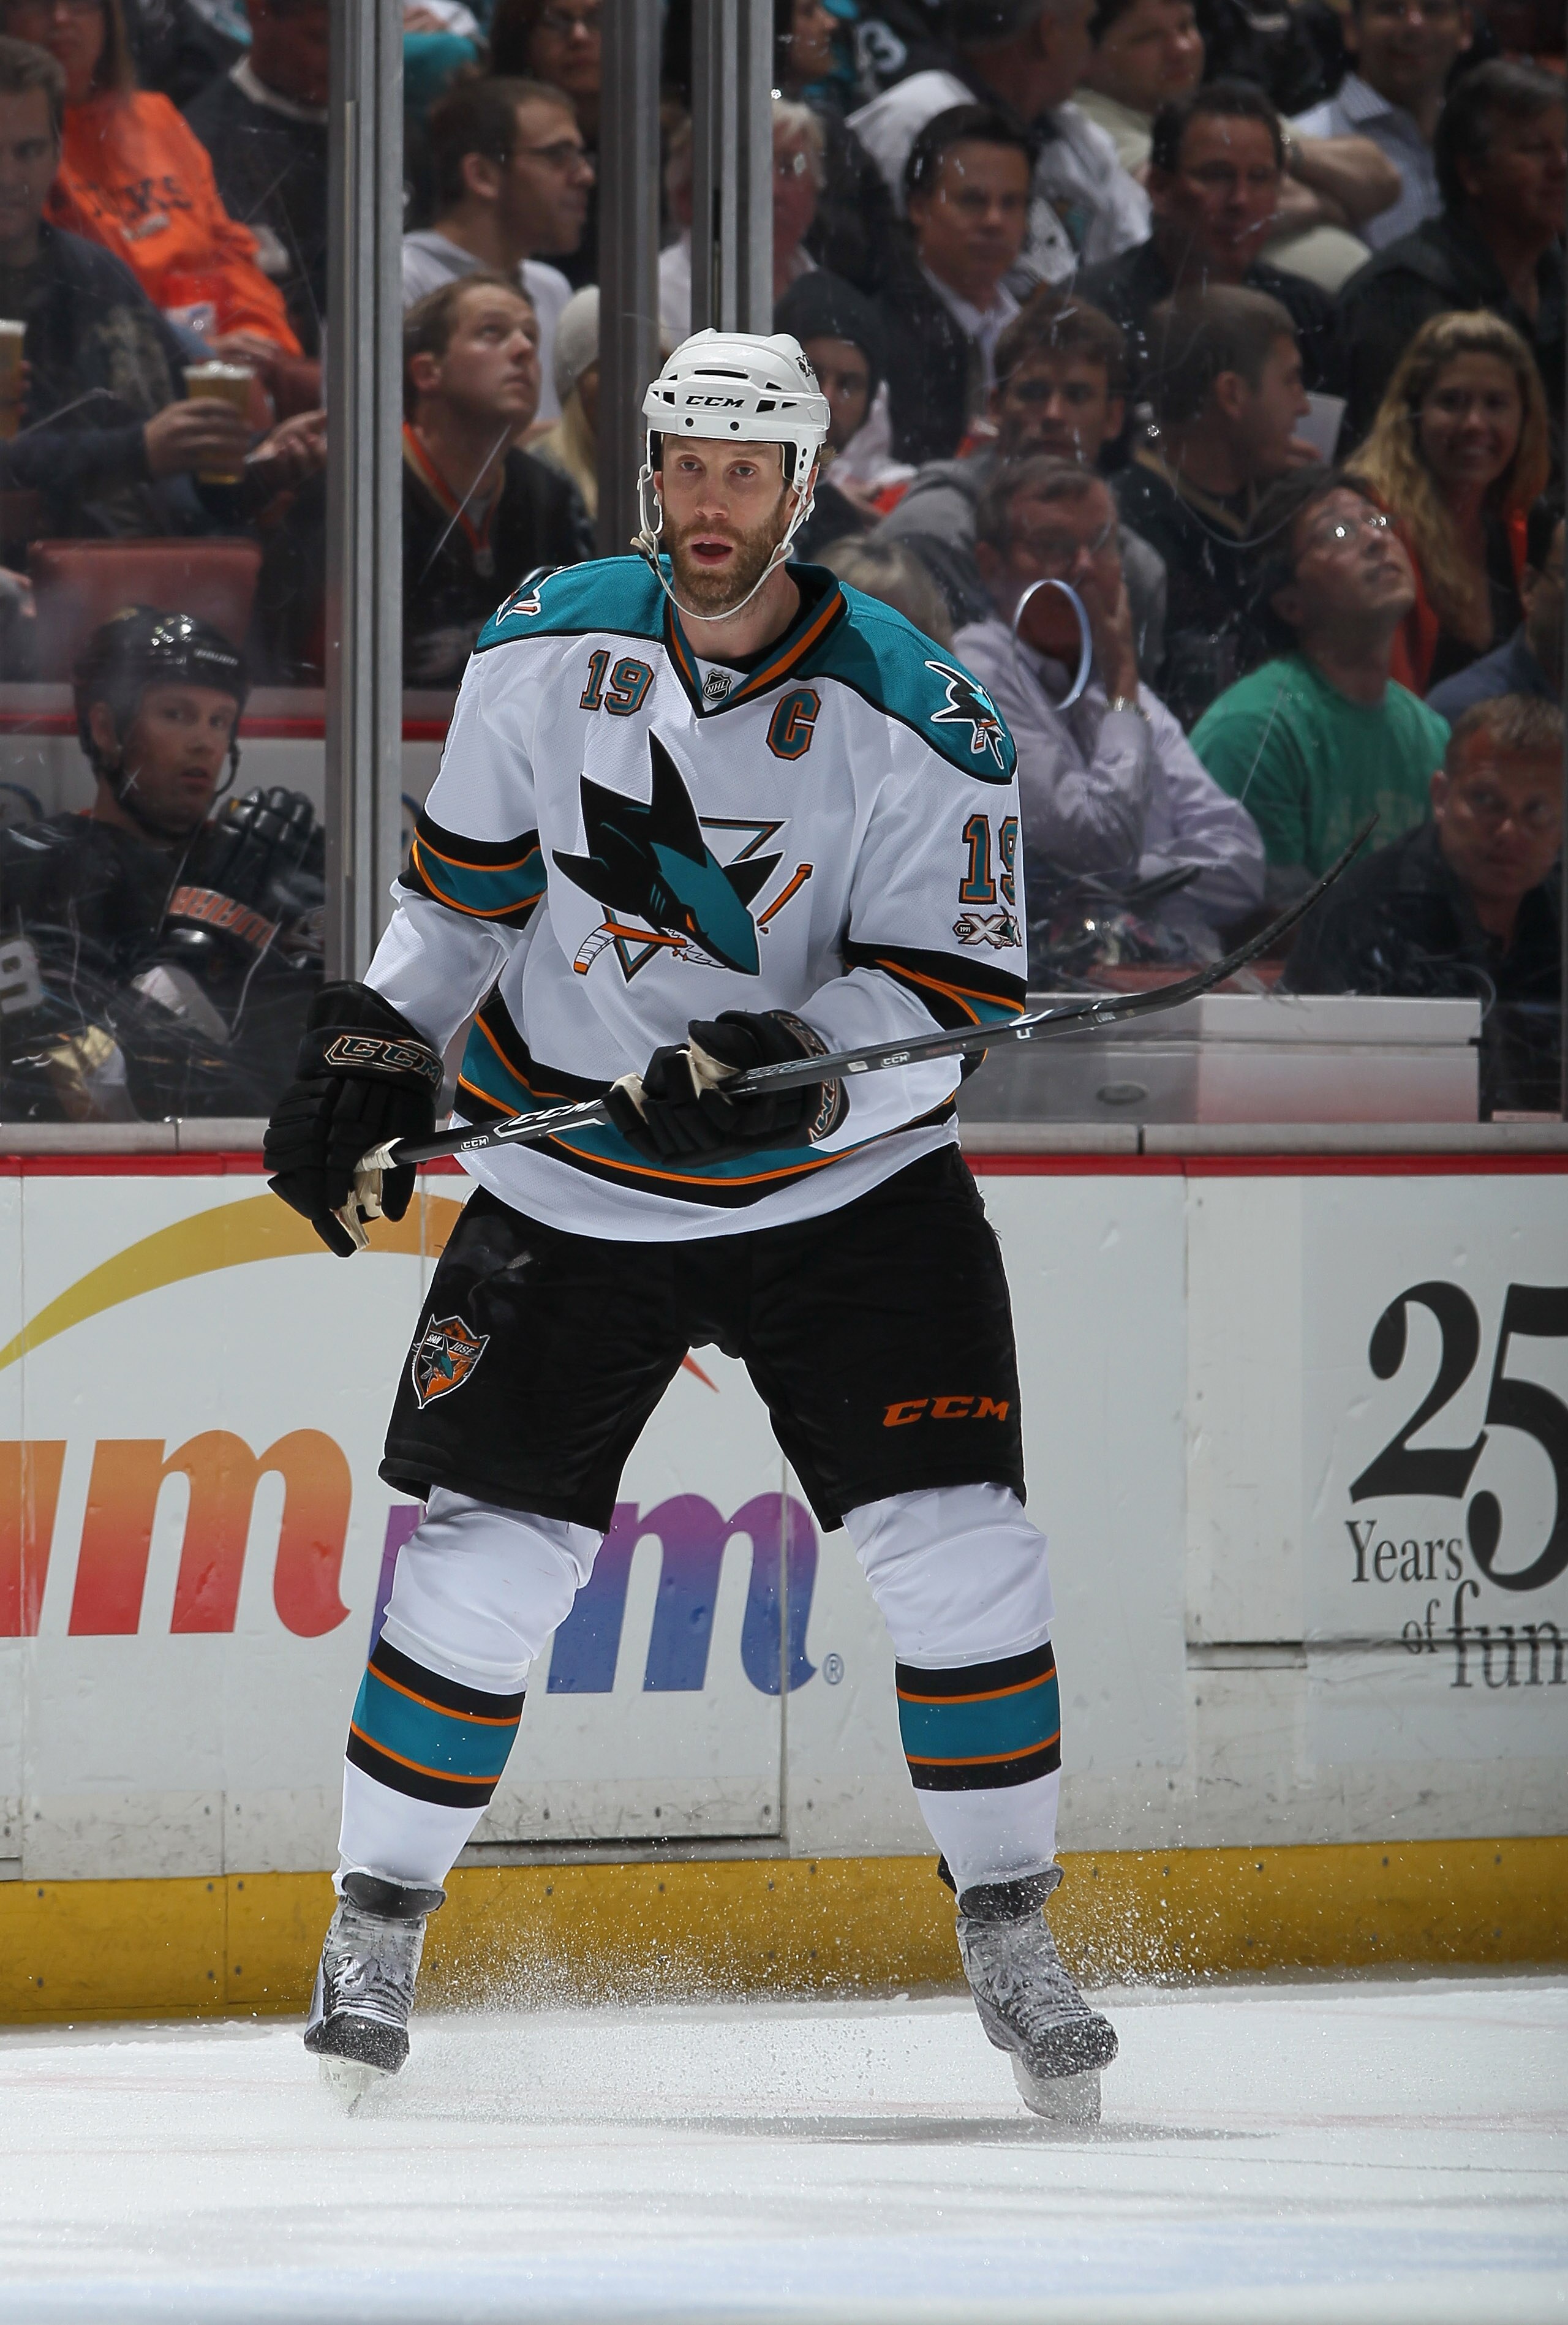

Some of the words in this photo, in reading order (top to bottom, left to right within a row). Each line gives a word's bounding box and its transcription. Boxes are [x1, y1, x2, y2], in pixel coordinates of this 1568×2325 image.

[685, 395, 745, 409] CCM
[579, 649, 655, 717] 19
[706, 681, 725, 694] NHL
[766, 688, 821, 761] C
[959, 814, 1018, 906] 19
[341, 1035, 441, 1083] CCM
[882, 1054, 909, 1066] CCM
[508, 1099, 603, 1126] CCM
[462, 1138, 488, 1150] CCM
[426, 1333, 443, 1344] SAN
[449, 1341, 475, 1355] JOSE
[883, 1395, 1010, 1428] CCM
[1349, 1280, 1568, 1591] 25
[1346, 1520, 1463, 1583] Years
[1401, 1599, 1440, 1655] of
[1447, 1579, 1568, 1688] fun
